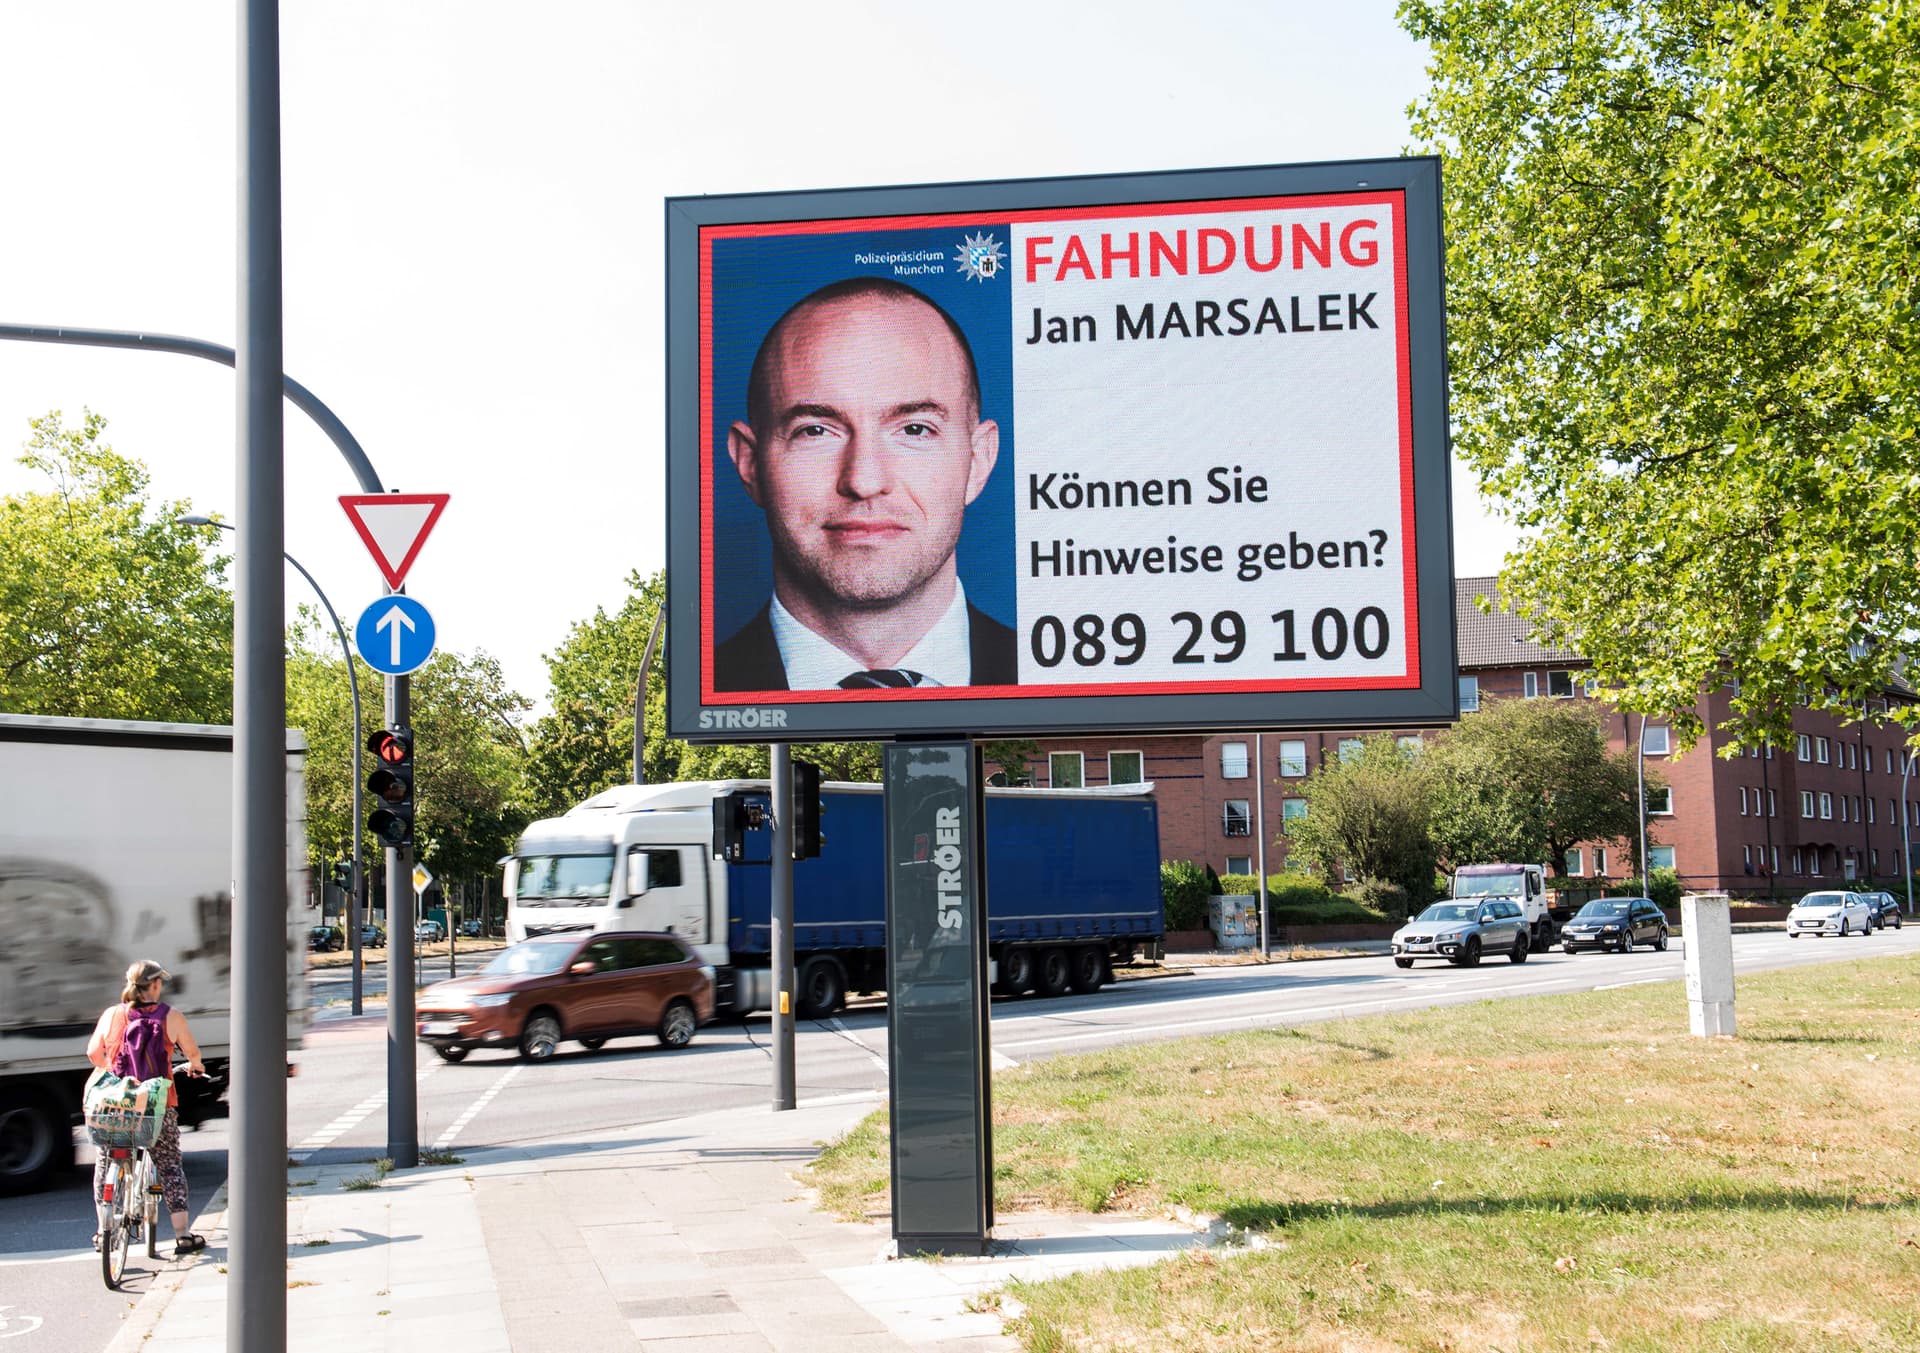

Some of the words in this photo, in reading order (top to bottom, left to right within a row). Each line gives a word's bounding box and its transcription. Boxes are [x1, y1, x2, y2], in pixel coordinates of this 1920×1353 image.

[854, 250, 944, 265] Polizeipräsidium
[1025, 219, 1379, 283] FAHNDUNG
[1026, 308, 1097, 345] Jan
[1116, 292, 1379, 341] MARSALEK
[1029, 472, 1192, 511] Können
[1207, 465, 1268, 504] Sie
[1030, 535, 1224, 578] Hinweise
[1236, 529, 1388, 582] geben?
[1030, 612, 1147, 668] 089
[1170, 610, 1247, 664] 29
[1271, 606, 1390, 661] 100
[699, 707, 787, 729] STRÖER
[933, 805, 963, 930] STRÖER
